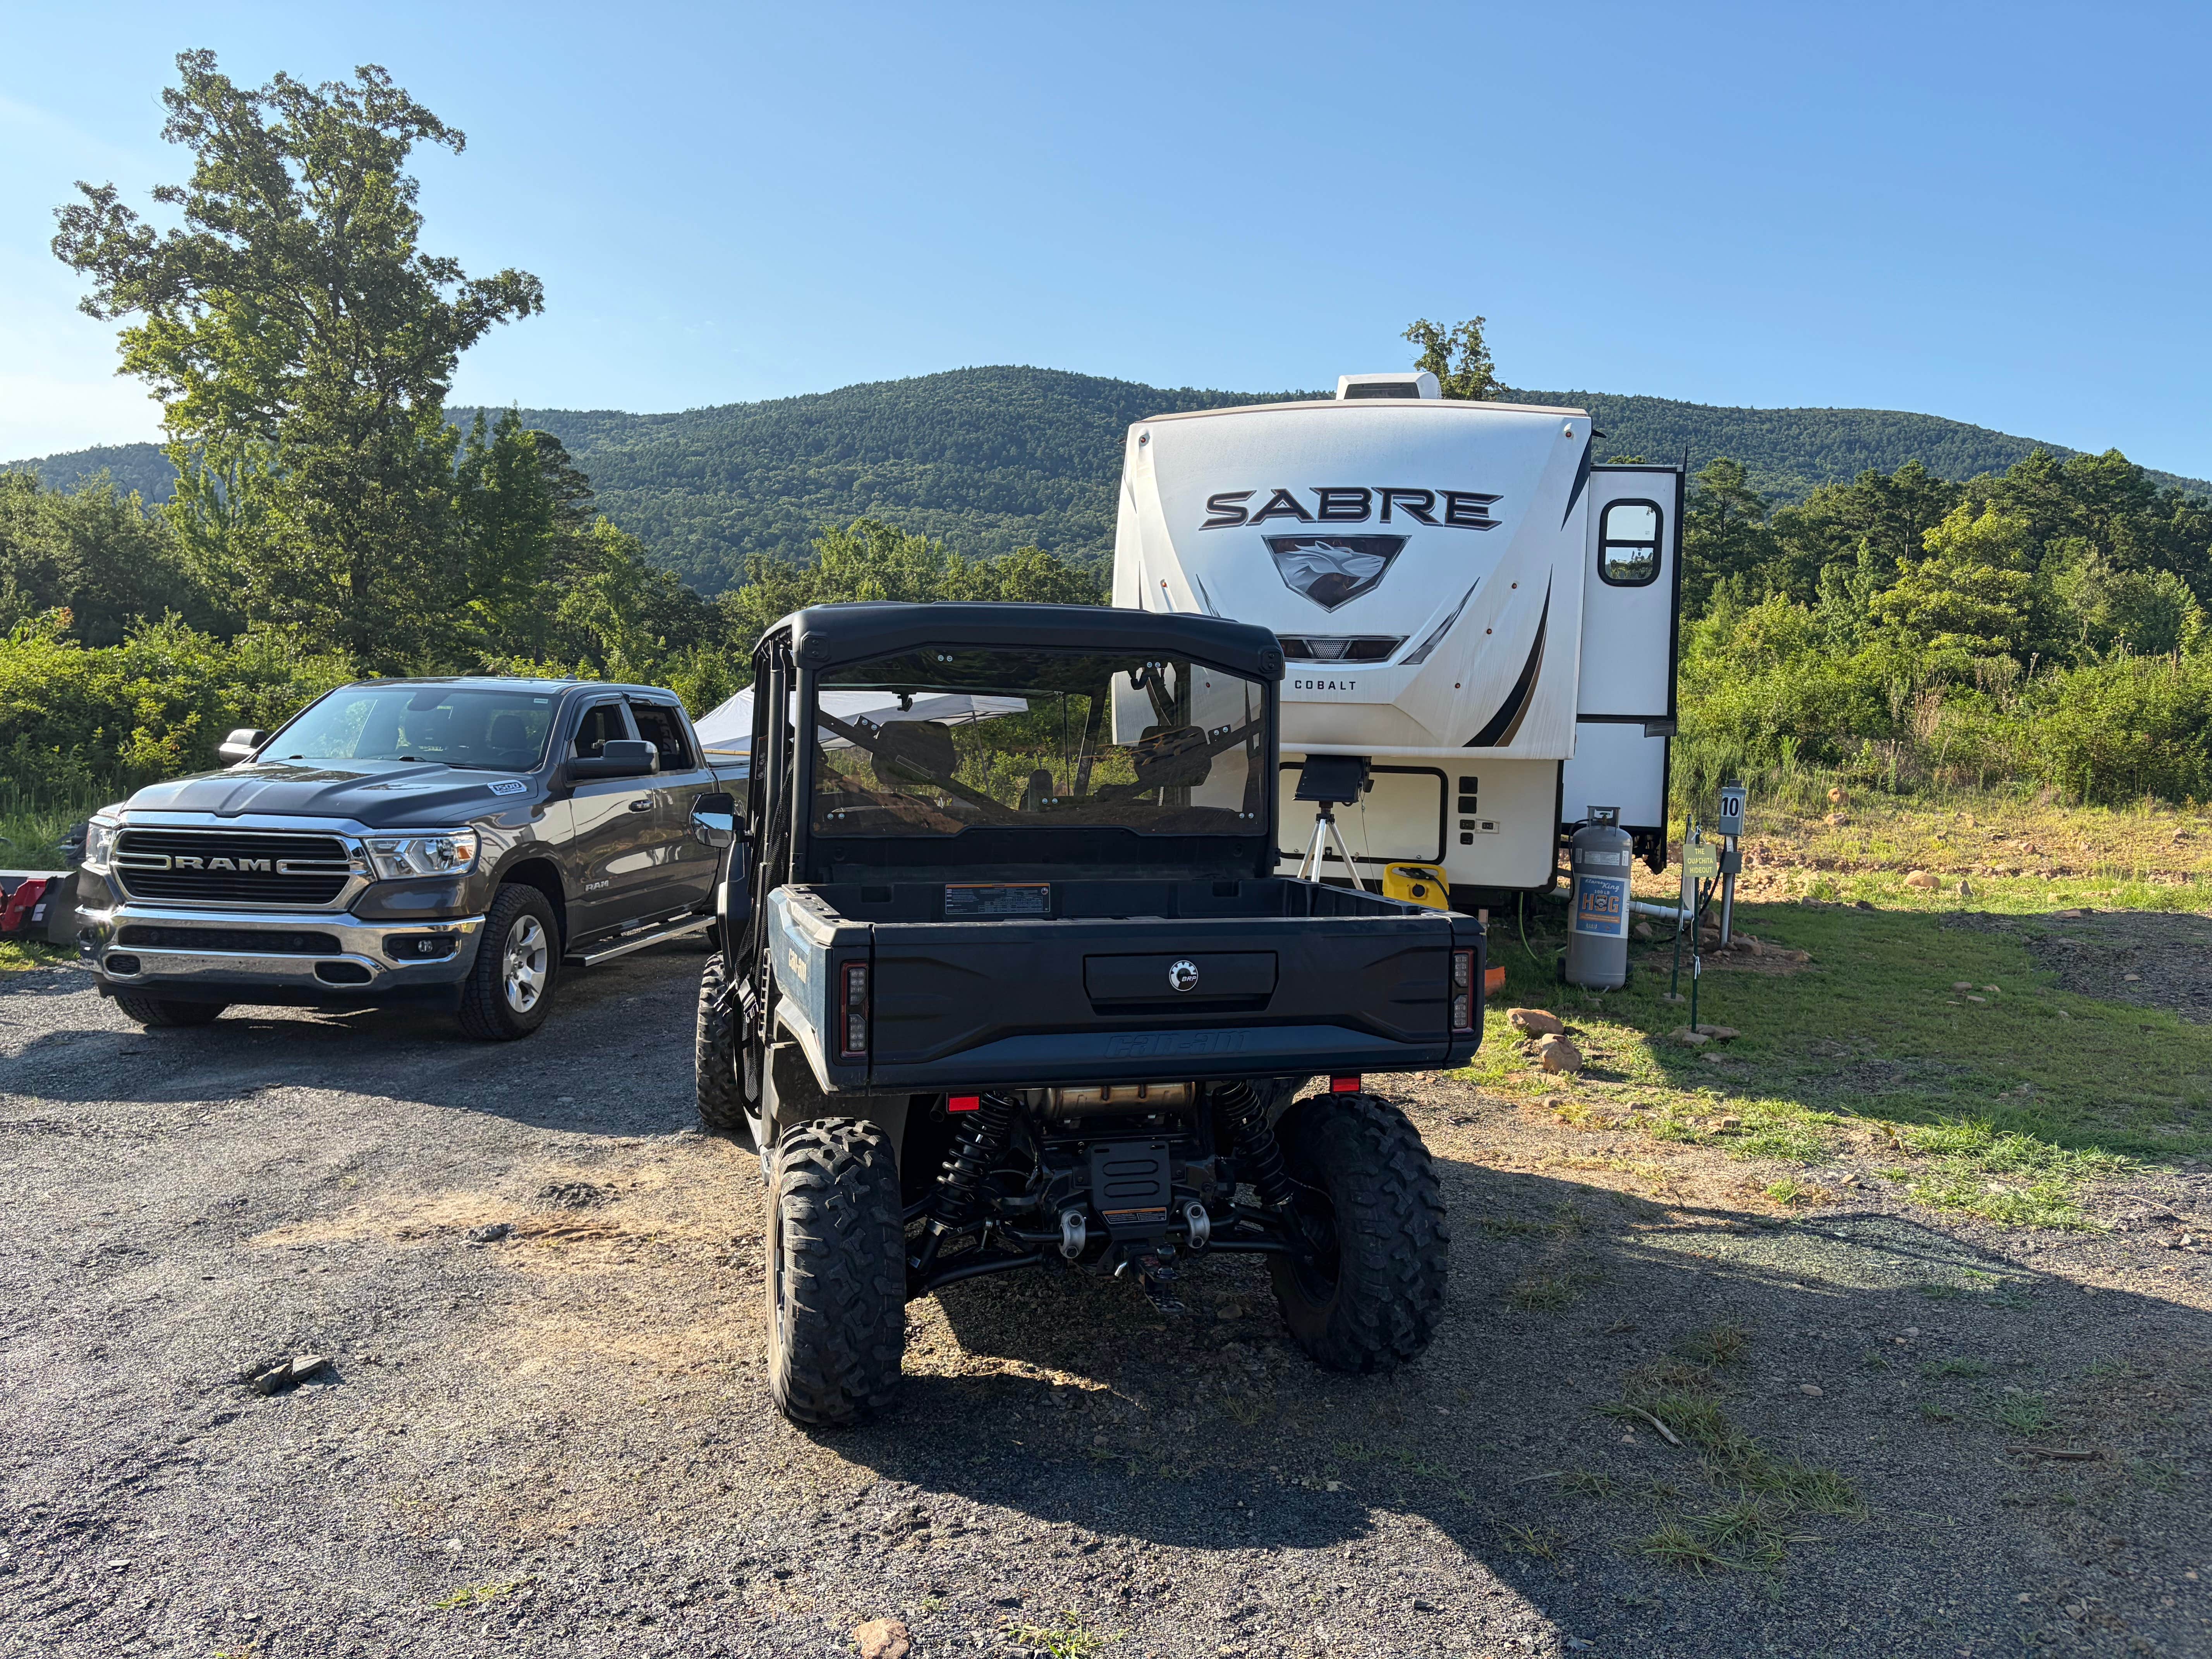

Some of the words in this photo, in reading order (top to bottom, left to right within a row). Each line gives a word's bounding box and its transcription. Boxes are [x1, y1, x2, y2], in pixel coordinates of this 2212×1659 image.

[1199, 487, 1504, 531] SABRE
[1295, 680, 1356, 690] COBALT
[494, 783, 519, 791] 1500
[1722, 797, 1739, 816] 10
[175, 856, 271, 871] RAM
[585, 880, 609, 892] RAM
[1602, 882, 1620, 892] King
[1582, 893, 1620, 913] HOG
[788, 948, 807, 984] can-am
[1105, 1031, 1251, 1059] can-am
